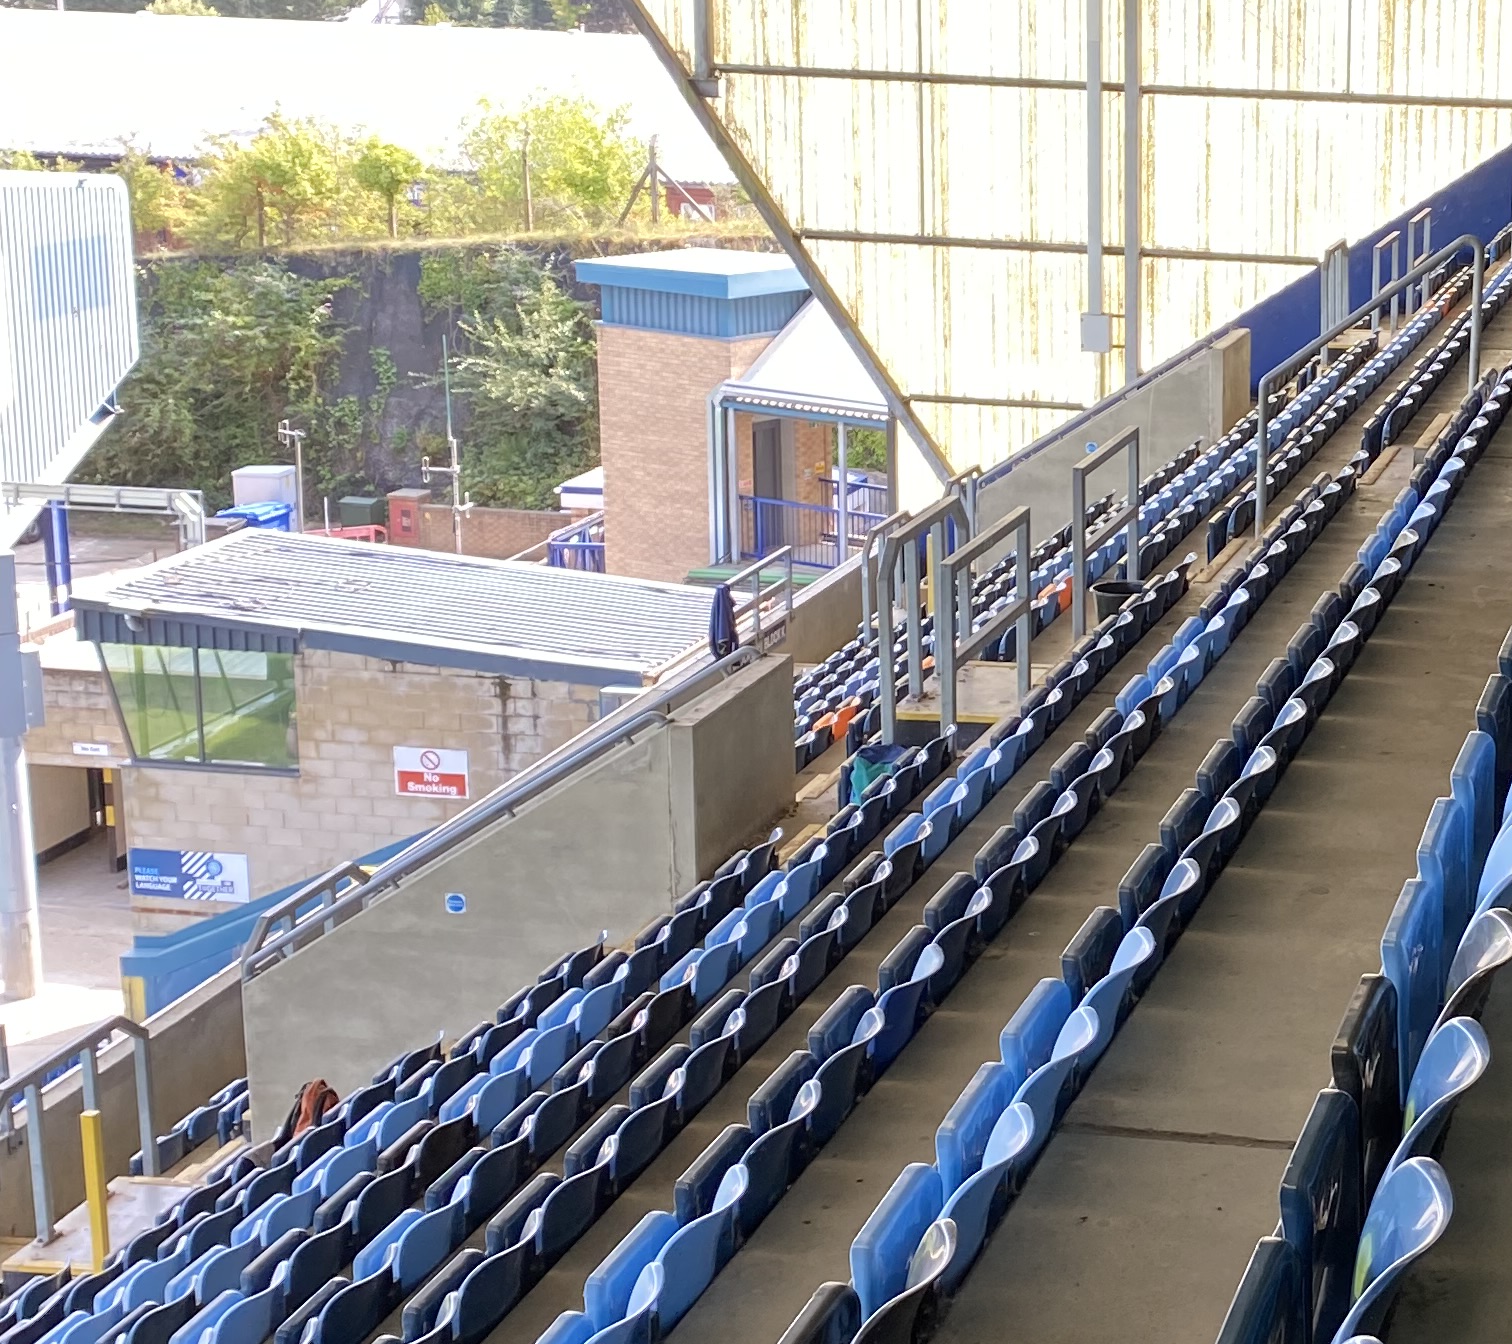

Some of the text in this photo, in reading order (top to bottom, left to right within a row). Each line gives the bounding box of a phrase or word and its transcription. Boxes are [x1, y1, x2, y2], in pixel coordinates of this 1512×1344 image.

[423, 772, 440, 783] No
[407, 781, 457, 795] Smoking
[134, 867, 159, 875] PLEASE
[134, 874, 159, 882] WATCH
[136, 882, 171, 891] LANGUAGE
